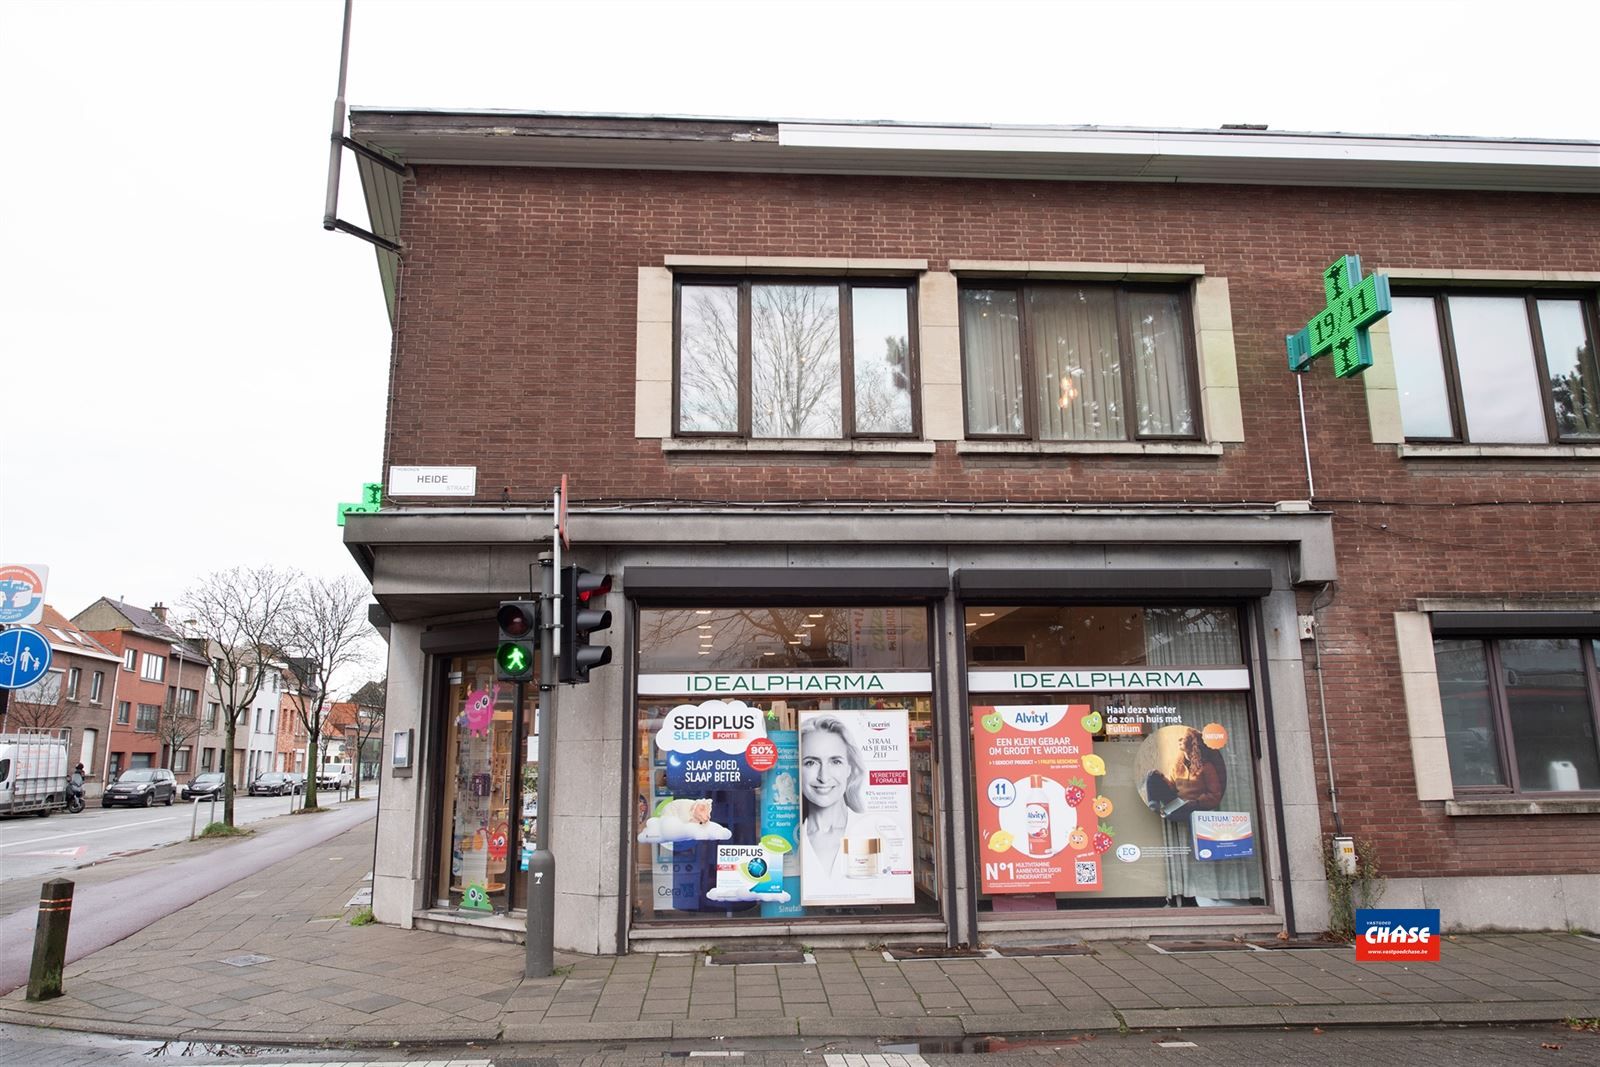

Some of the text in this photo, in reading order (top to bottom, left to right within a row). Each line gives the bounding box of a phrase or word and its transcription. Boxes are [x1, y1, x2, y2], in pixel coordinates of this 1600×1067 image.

[416, 475, 448, 484] HEIDE
[687, 674, 884, 691] IDEALPHARMA
[1013, 671, 1203, 688] IDEALPHARMA
[1106, 706, 1176, 714] Haal deze winter
[673, 715, 755, 730] SEDIPLUS
[1015, 712, 1049, 725] Alvityl
[1107, 715, 1118, 723] de
[1137, 715, 1144, 723] in
[1146, 715, 1164, 723] huis
[1165, 715, 1182, 723] met
[1108, 725, 1140, 733] Fultium
[673, 731, 710, 740] SLEEP
[1014, 738, 1036, 746] KLEIN
[1038, 737, 1070, 745] GEBAAR
[751, 746, 774, 755] 90%
[989, 747, 1001, 755] OM
[1003, 747, 1030, 755] GROOT
[1043, 746, 1079, 754] WORDEN
[686, 760, 713, 771] SLAAP
[685, 771, 741, 782] SLAAP BETER
[995, 783, 1006, 795] 11
[719, 848, 763, 857] SEDIPLUS
[1122, 848, 1136, 856] EG
